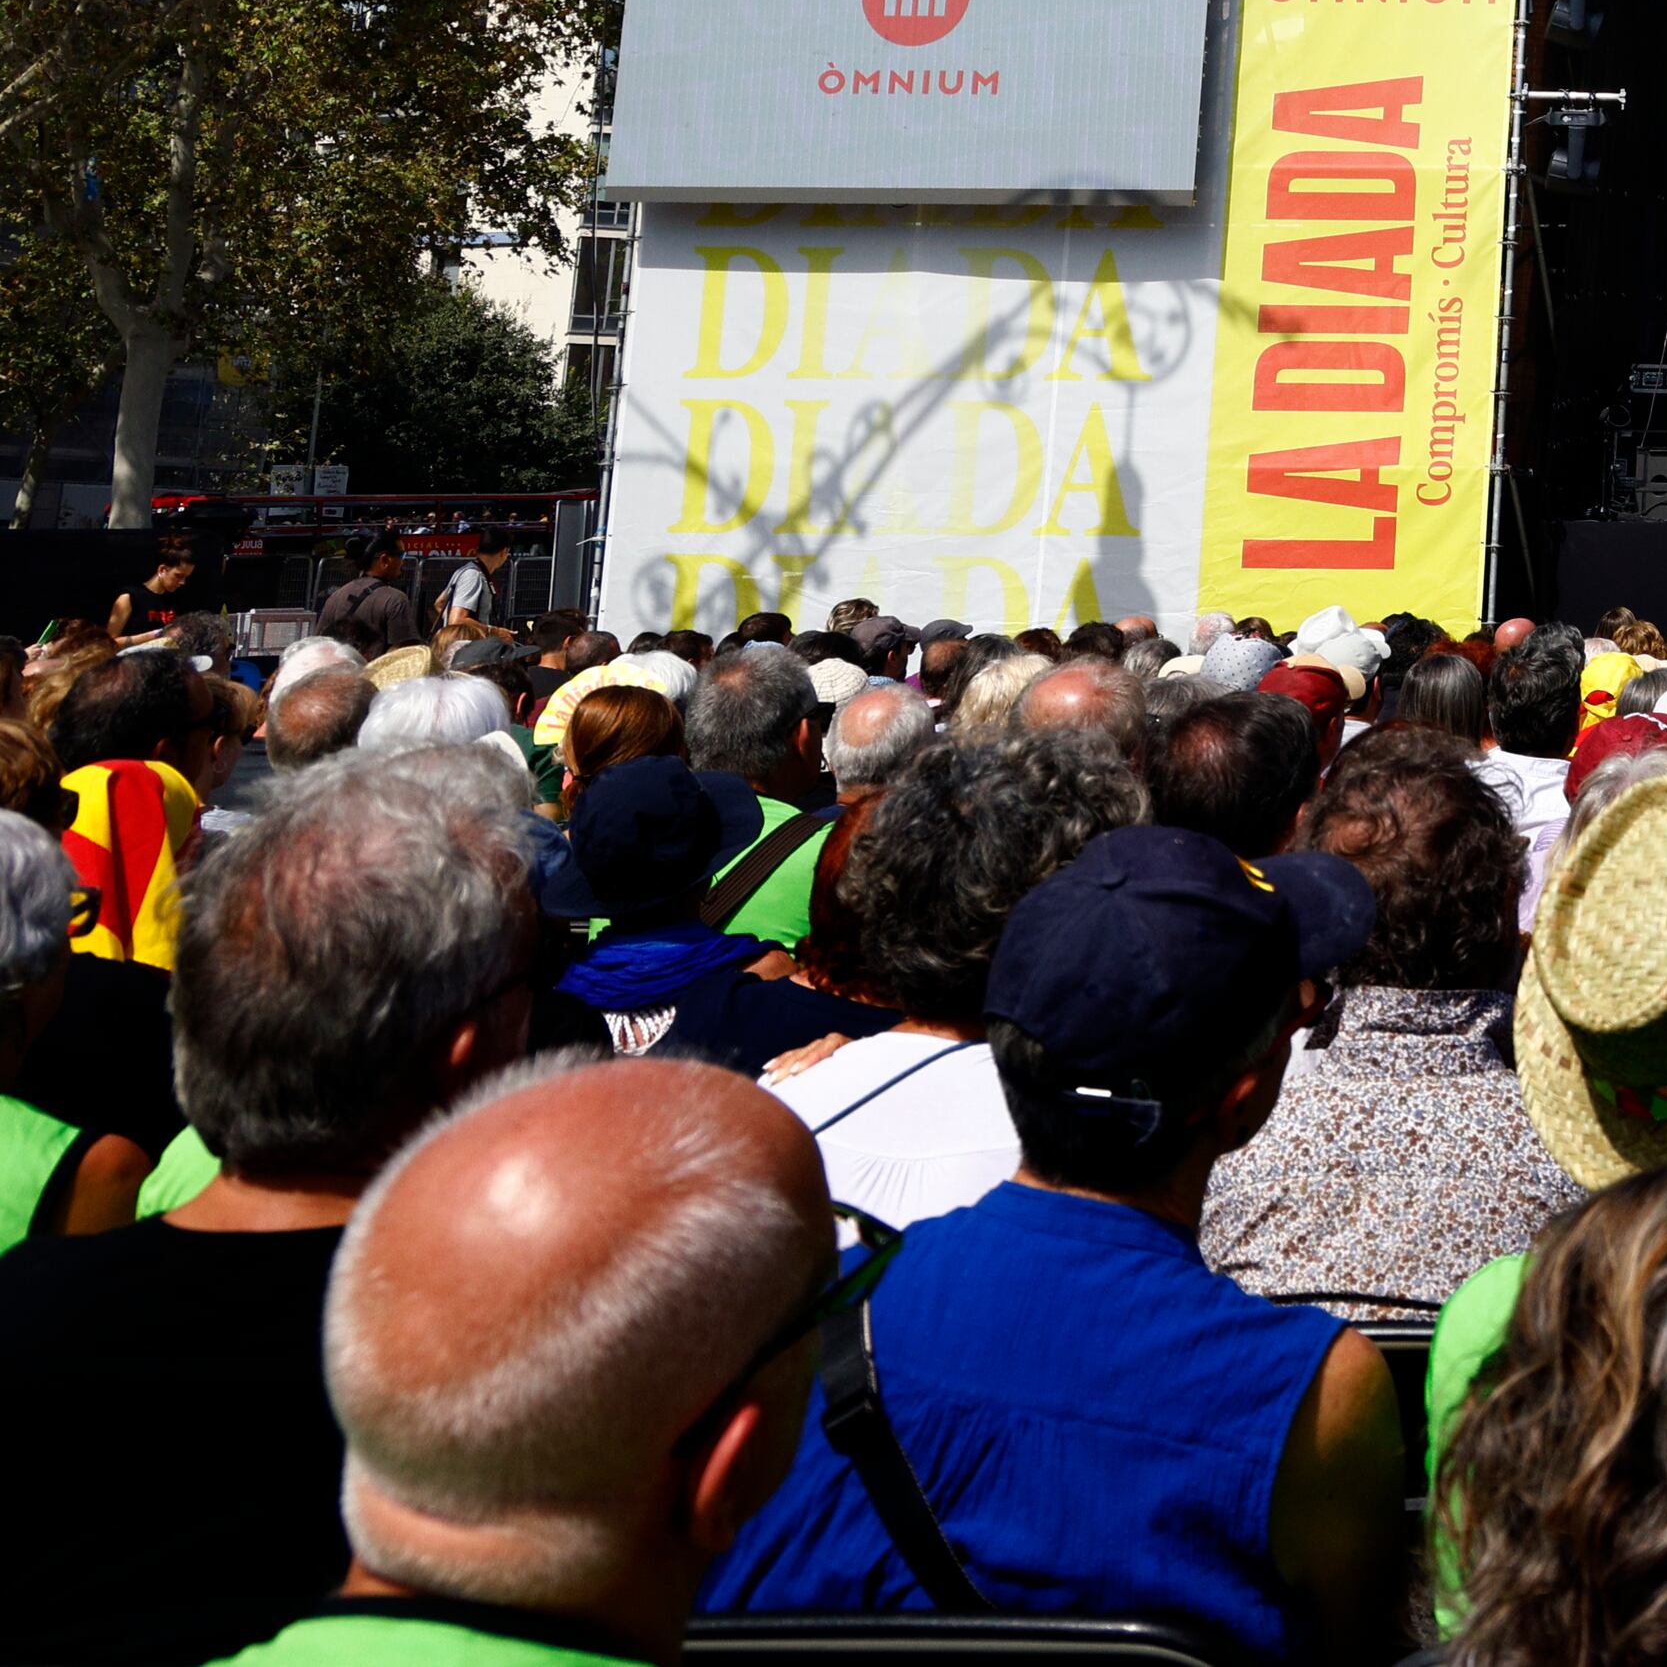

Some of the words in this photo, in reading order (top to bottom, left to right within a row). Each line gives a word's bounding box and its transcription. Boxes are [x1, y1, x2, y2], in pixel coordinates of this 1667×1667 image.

[818, 62, 999, 96] ÒMNIUM
[1252, 75, 1424, 413] DIADA
[1429, 137, 1473, 269] Cultura
[1414, 295, 1466, 508] Compromís
[1240, 436, 1404, 571] LA
